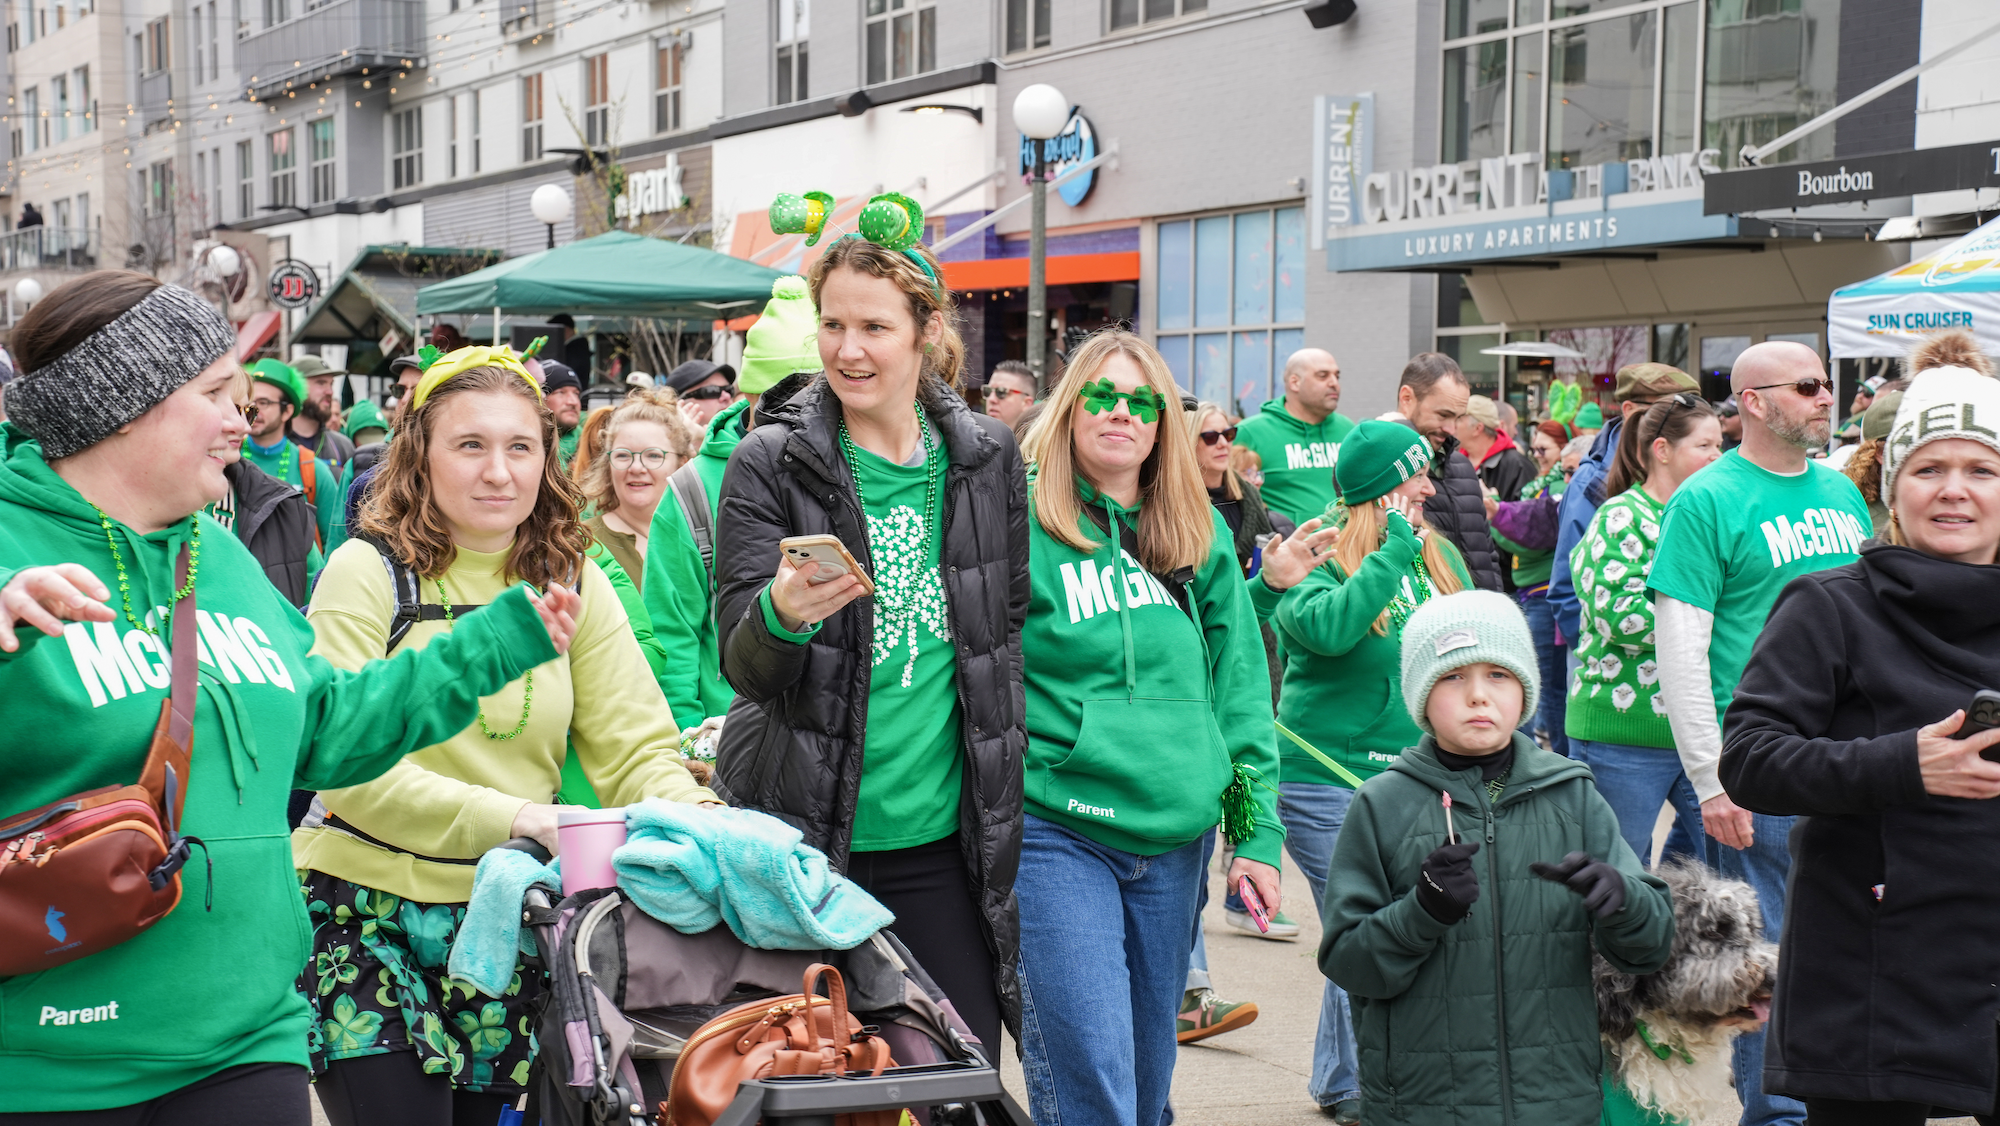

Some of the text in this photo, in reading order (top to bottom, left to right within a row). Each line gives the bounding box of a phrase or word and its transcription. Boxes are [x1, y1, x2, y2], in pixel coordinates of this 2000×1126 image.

[1328, 103, 1353, 228] URRENT
[628, 152, 684, 229] park
[1363, 153, 1538, 225] CURRENT
[1627, 149, 1721, 194] BANKS
[1798, 166, 1874, 196] Bourbon
[1405, 216, 1618, 257] LUXURY APARTMENTS
[1867, 311, 1973, 331] SUN CRUISER
[1285, 442, 1342, 470] McGIN
[1067, 798, 1116, 818] Parent
[39, 1000, 119, 1026] Parent
